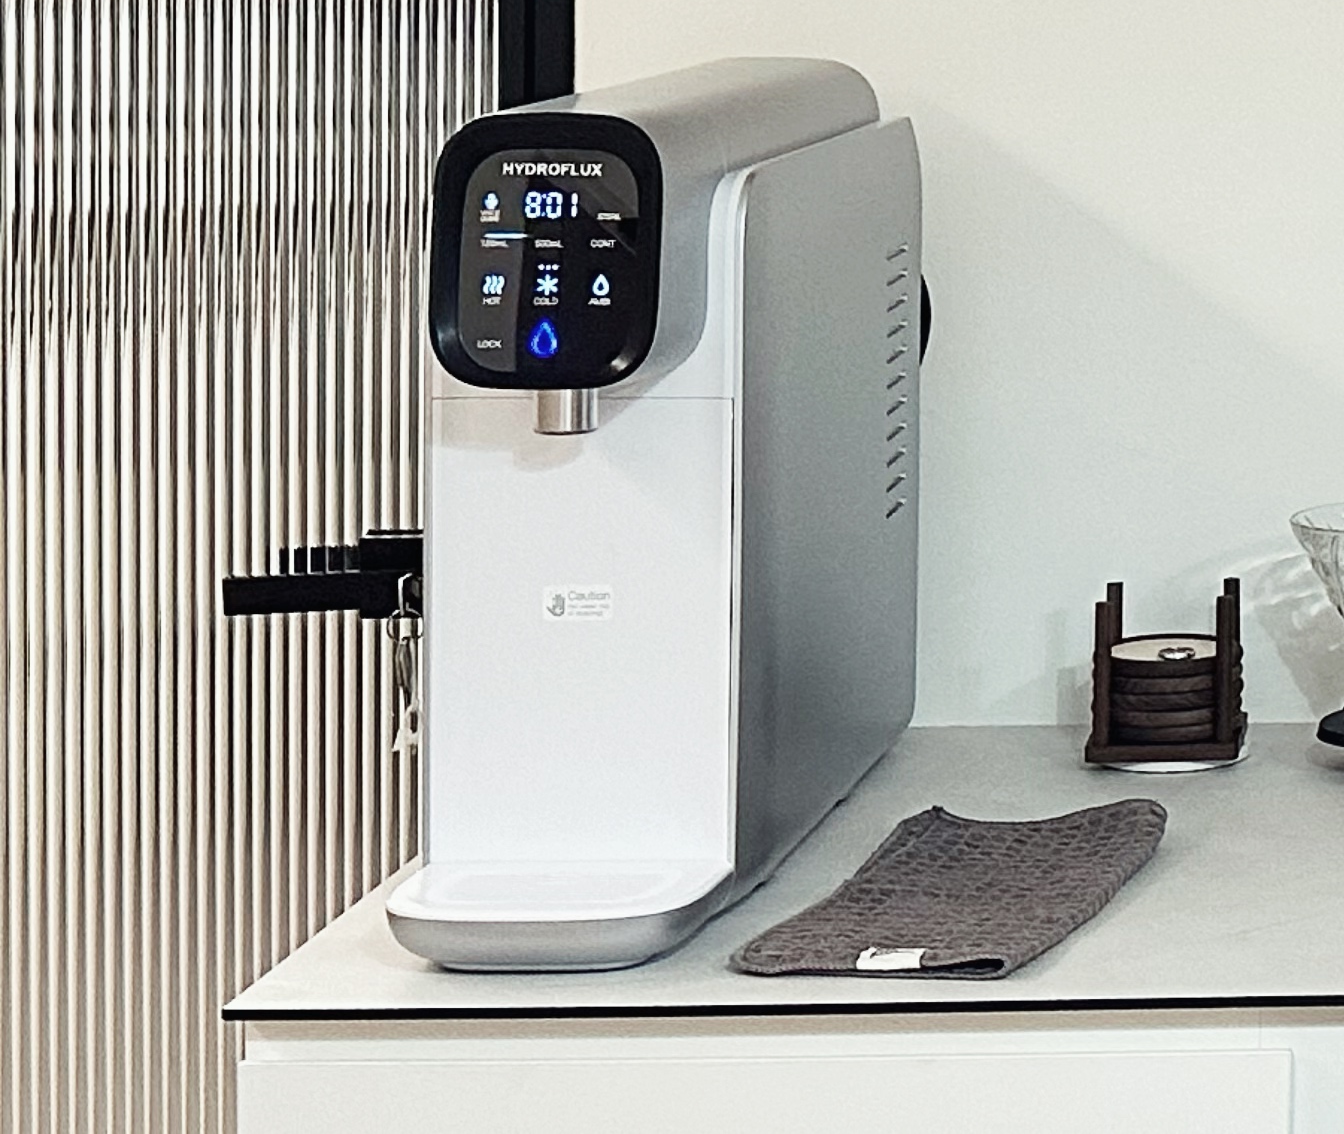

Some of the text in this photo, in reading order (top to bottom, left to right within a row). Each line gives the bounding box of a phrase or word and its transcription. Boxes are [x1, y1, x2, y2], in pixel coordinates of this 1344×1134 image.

[502, 162, 603, 177] HYDROFLUX
[523, 191, 579, 220] 8:01
[477, 340, 502, 349] LOCK
